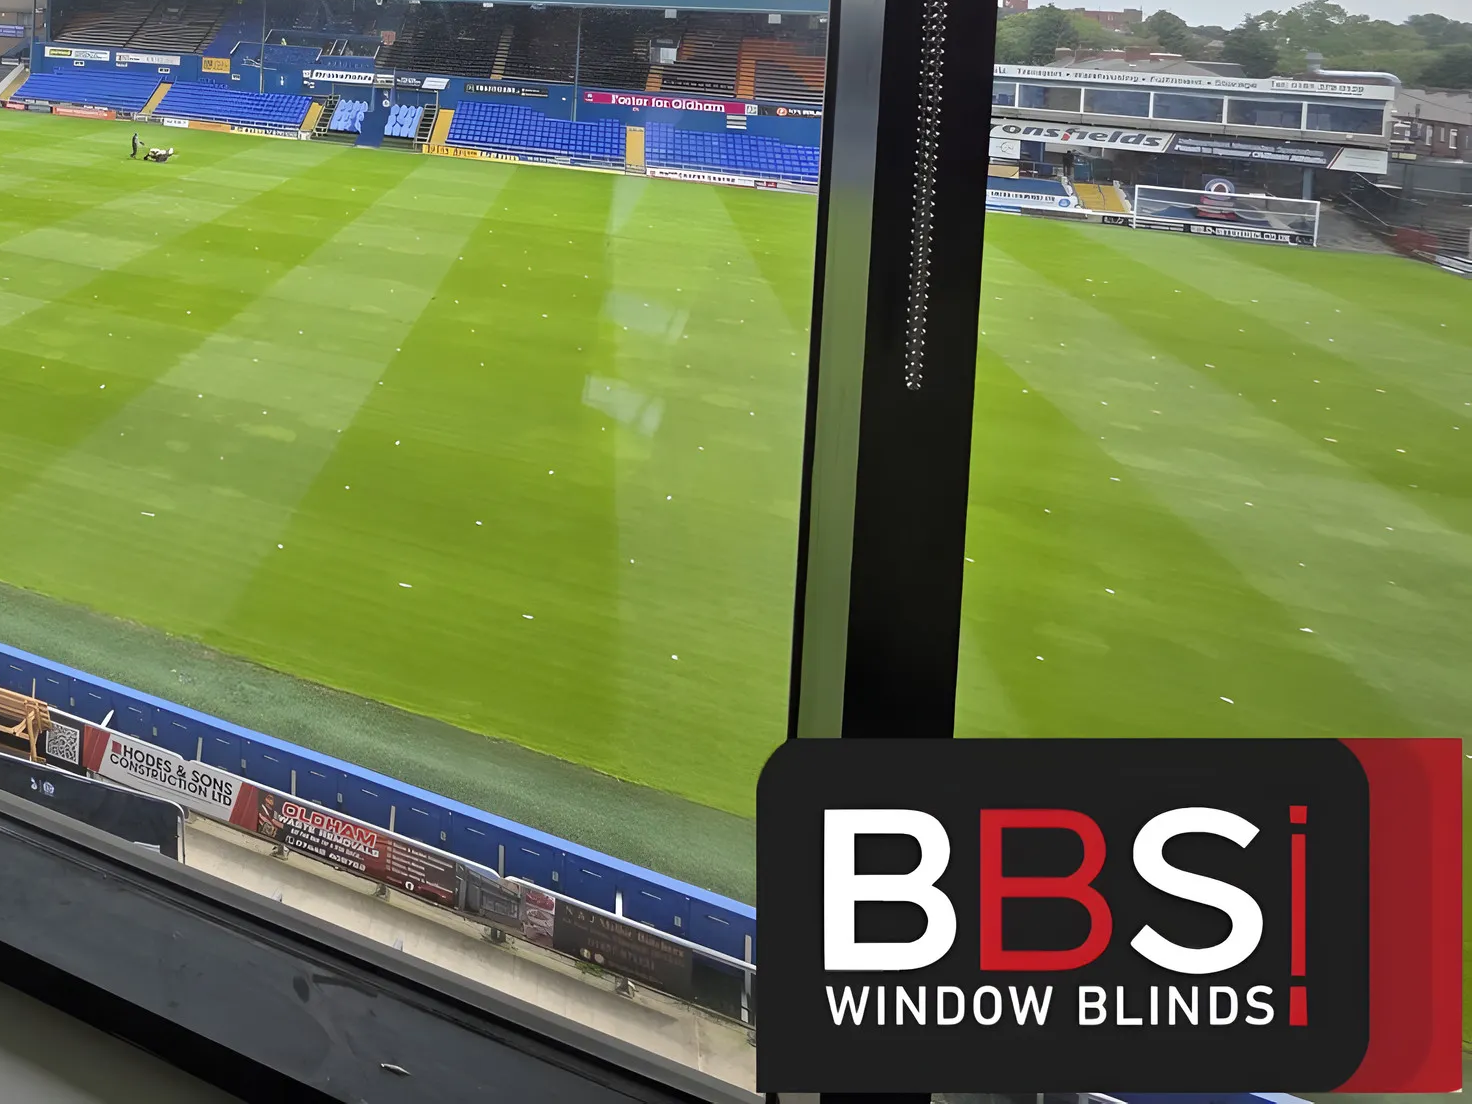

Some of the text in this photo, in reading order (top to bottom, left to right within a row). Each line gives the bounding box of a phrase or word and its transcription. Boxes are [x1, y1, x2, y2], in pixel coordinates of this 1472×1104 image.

[672, 98, 725, 113] Oldham
[109, 753, 233, 807] CONSTRUCTION LTD
[176, 764, 187, 779] &
[191, 769, 233, 797] SONS
[282, 801, 378, 849] OLDHAM
